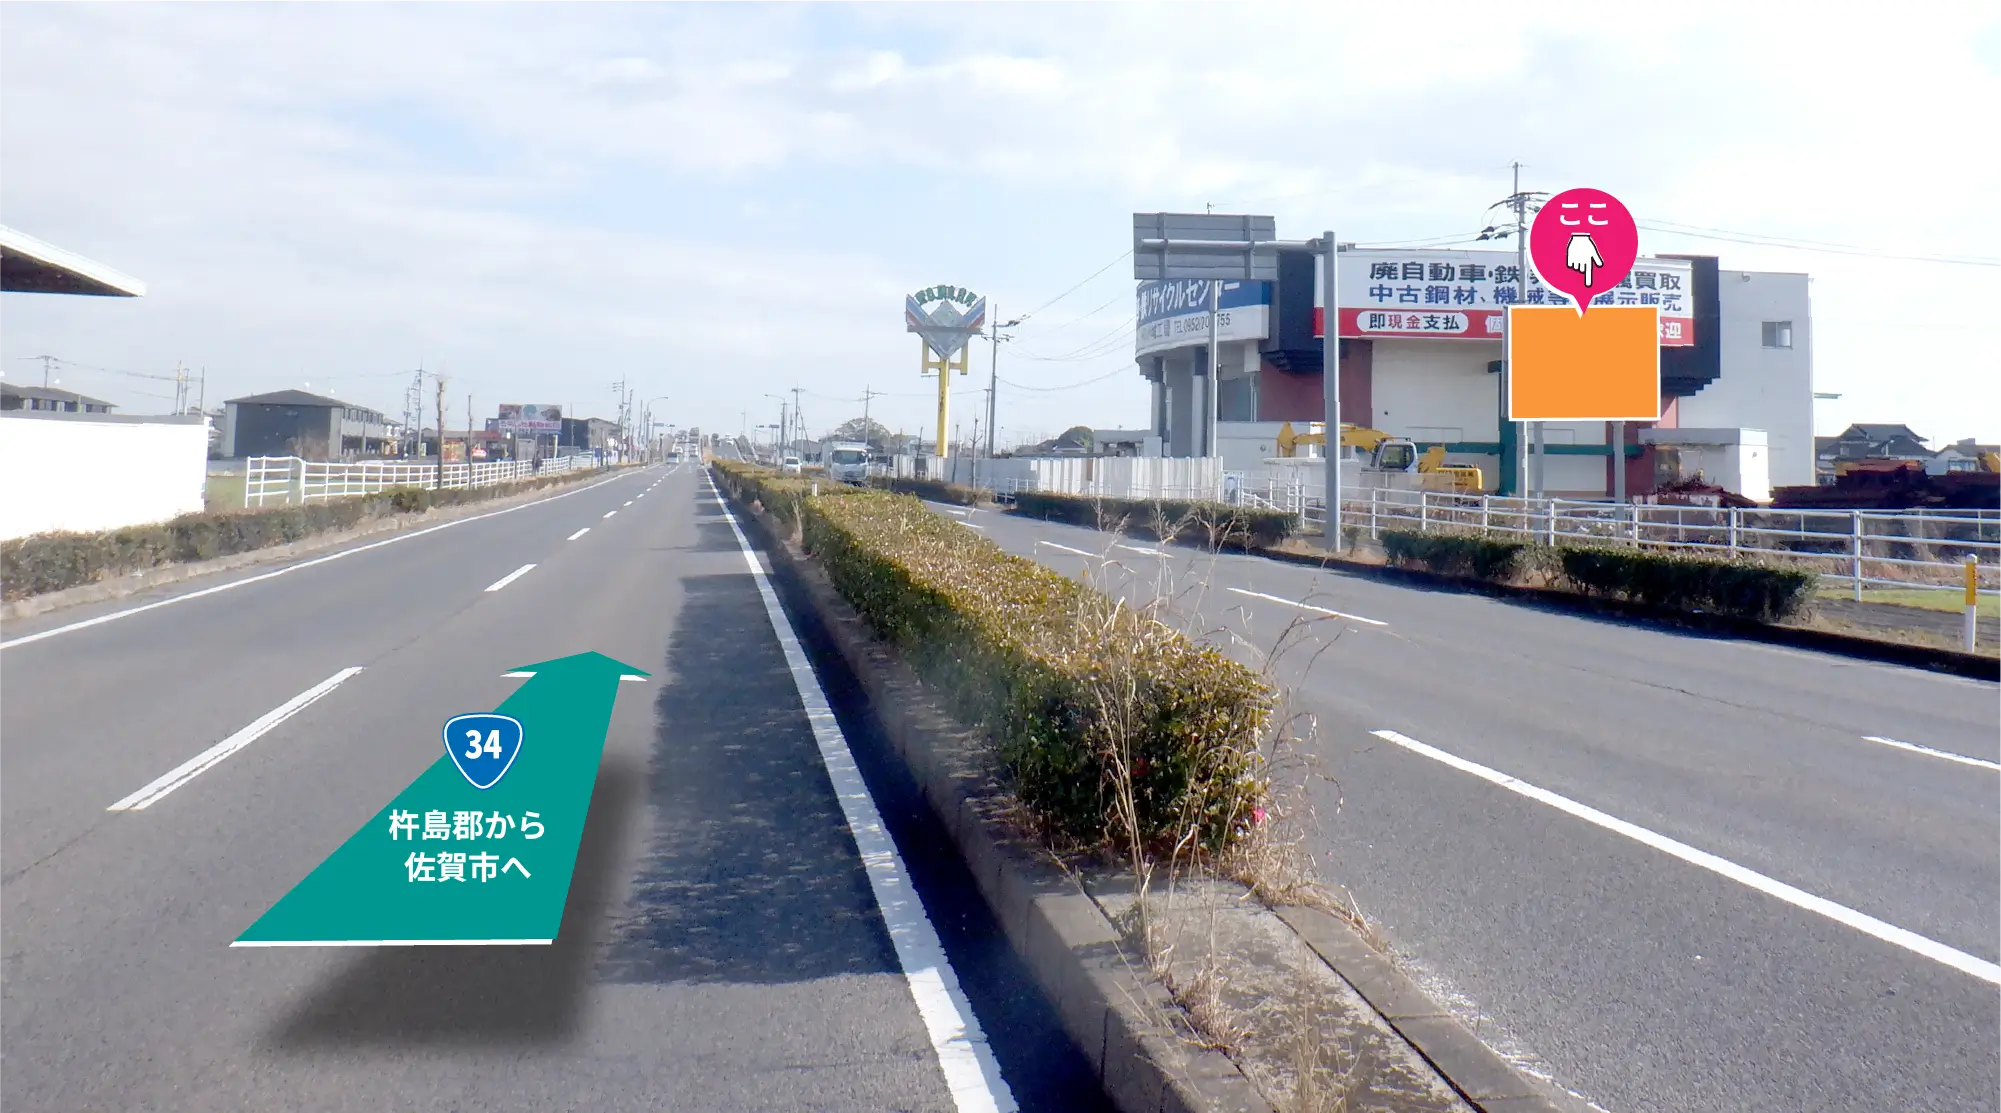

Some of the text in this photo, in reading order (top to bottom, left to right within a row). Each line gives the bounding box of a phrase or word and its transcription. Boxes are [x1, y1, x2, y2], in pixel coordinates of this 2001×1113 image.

[1369, 312, 1460, 330] 即現金支払
